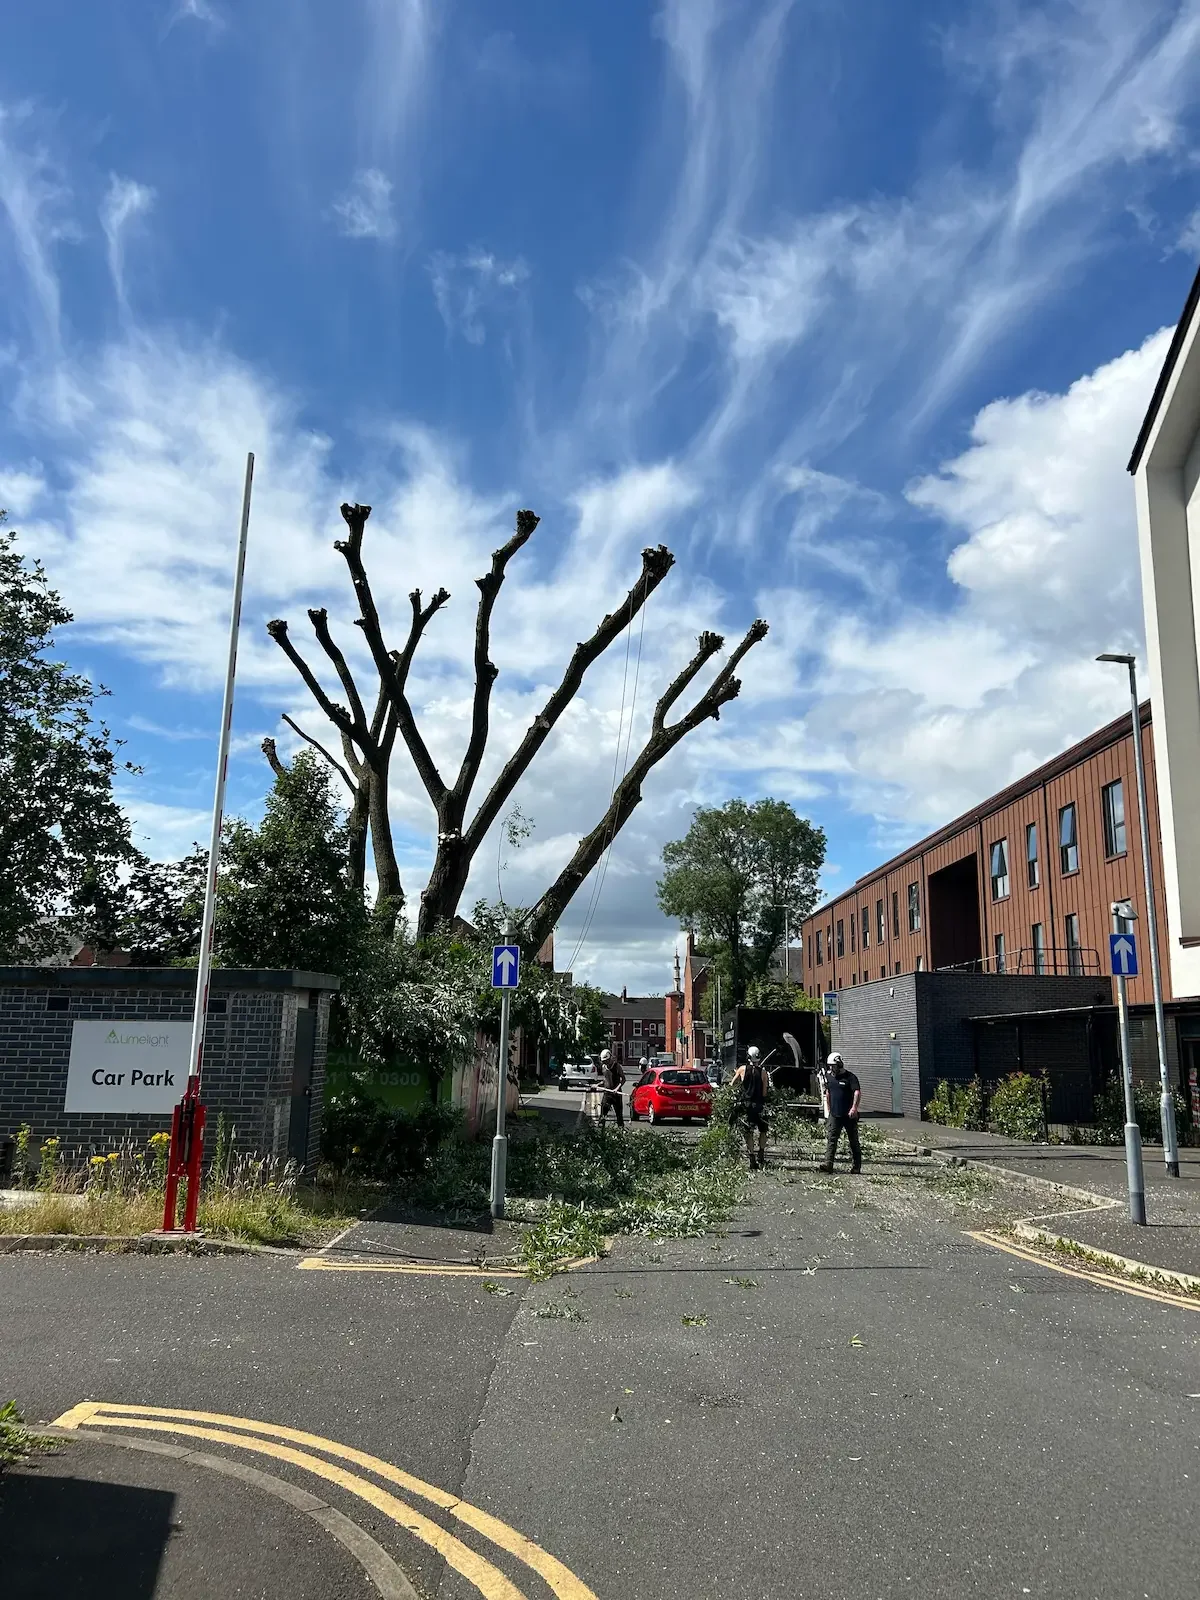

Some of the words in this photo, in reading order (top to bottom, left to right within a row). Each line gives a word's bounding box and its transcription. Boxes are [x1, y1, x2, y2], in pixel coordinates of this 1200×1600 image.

[120, 1033, 169, 1047] Limelight
[91, 1068, 126, 1086] Car
[131, 1069, 175, 1087] Park
[380, 1071, 421, 1086] 0300
